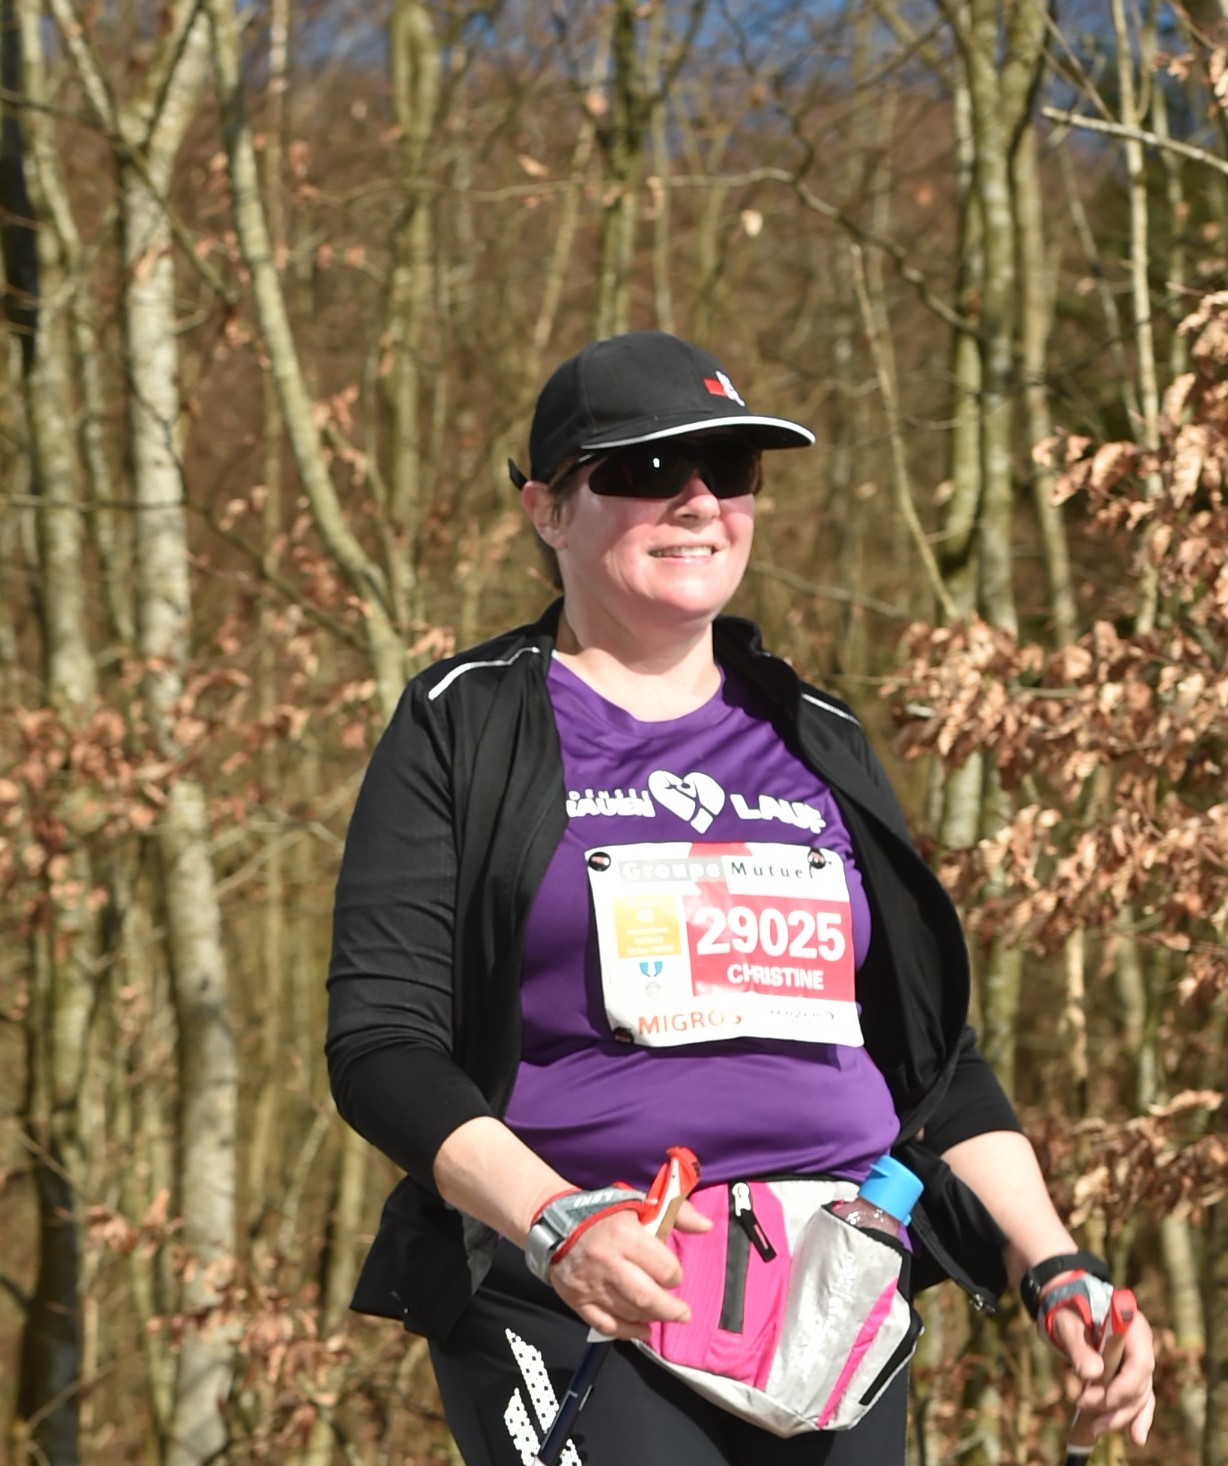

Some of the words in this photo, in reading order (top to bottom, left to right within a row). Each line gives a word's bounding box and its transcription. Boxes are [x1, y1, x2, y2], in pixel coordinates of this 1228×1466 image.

[730, 793, 826, 835] LAUF
[622, 859, 723, 881] Groupe
[694, 906, 846, 962] 29025
[727, 963, 824, 990] CHRISTINE
